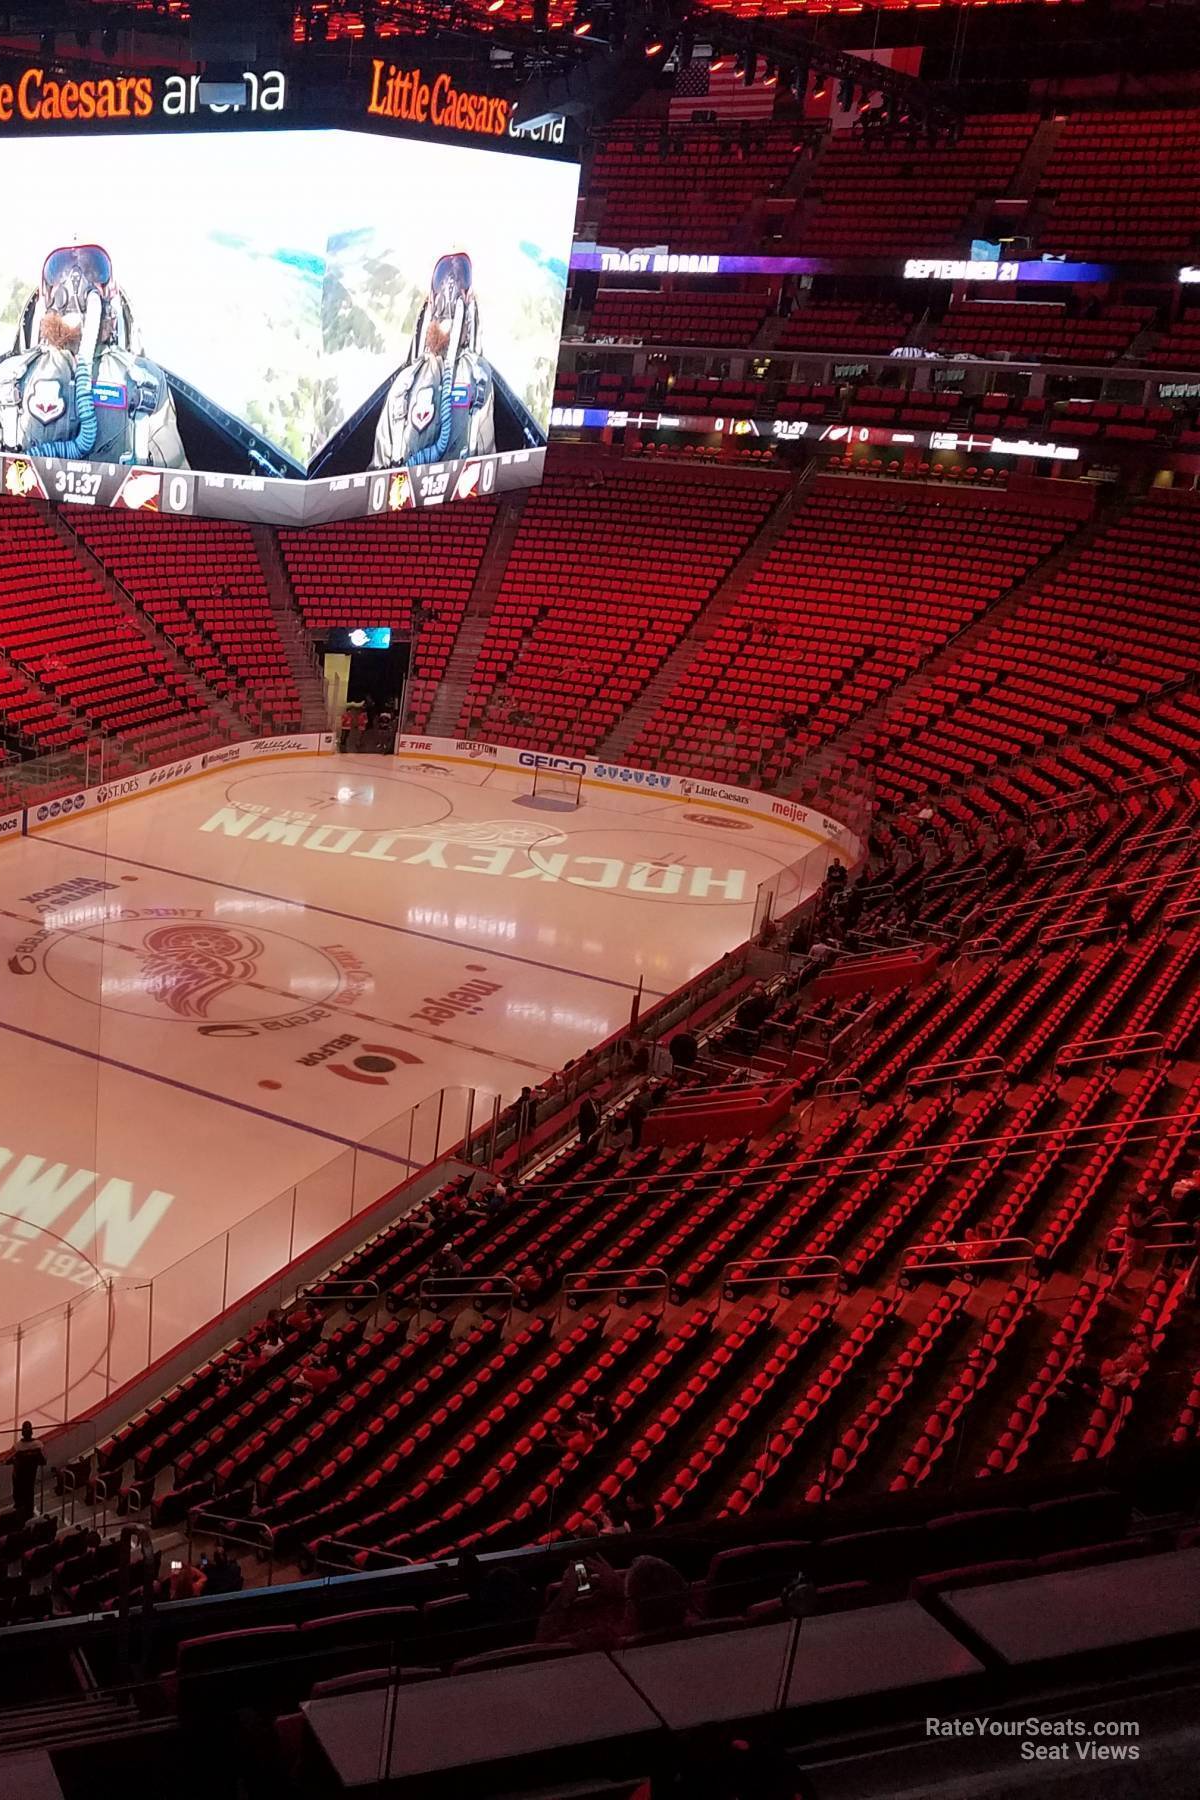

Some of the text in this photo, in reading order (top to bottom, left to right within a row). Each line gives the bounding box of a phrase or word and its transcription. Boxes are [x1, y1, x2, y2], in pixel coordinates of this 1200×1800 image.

[18, 68, 153, 119] Caesars
[163, 70, 286, 115] arna
[368, 59, 428, 122] Little
[431, 73, 508, 136] Caesars
[601, 253, 650, 272] TRACY
[903, 259, 1019, 281] SEPTEMBER 21
[55, 470, 102, 495] 31:37
[420, 472, 449, 497] 31:37
[482, 462, 494, 492] 0
[170, 476, 188, 511] 0
[372, 477, 386, 511] 0
[409, 742, 432, 751] TIRE
[455, 741, 498, 757] HOCKEYTOWN
[518, 752, 586, 776] GEICO
[695, 785, 750, 804] Little Caesars
[771, 801, 809, 823] meijer
[198, 806, 747, 900] HOCKEYTOWN
[409, 979, 503, 1026] meijer
[261, 1008, 332, 1032] arena
[295, 1033, 360, 1067] BELFOR
